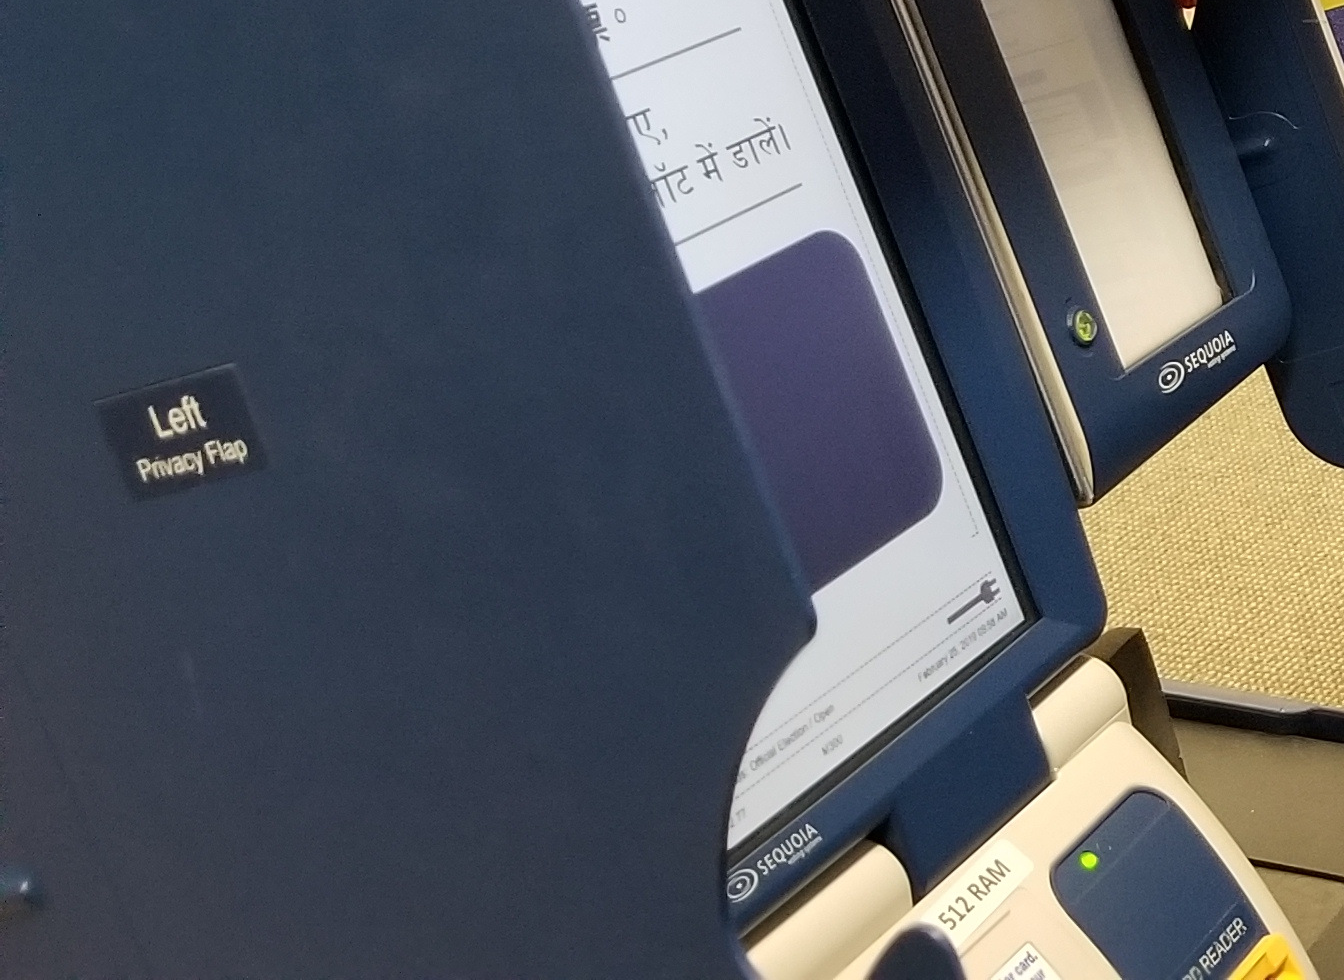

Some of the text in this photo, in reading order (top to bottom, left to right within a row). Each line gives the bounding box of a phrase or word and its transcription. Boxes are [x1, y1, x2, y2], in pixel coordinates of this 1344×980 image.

[695, 142, 724, 182] में
[1184, 330, 1235, 373] SEQUOIA
[147, 395, 207, 438] Left
[136, 439, 248, 481] Privacy Flap
[757, 823, 818, 875] SEQUOIA
[938, 859, 1011, 931] 512 RAM
[1014, 950, 1039, 977] card.
[1199, 917, 1247, 975] READER
